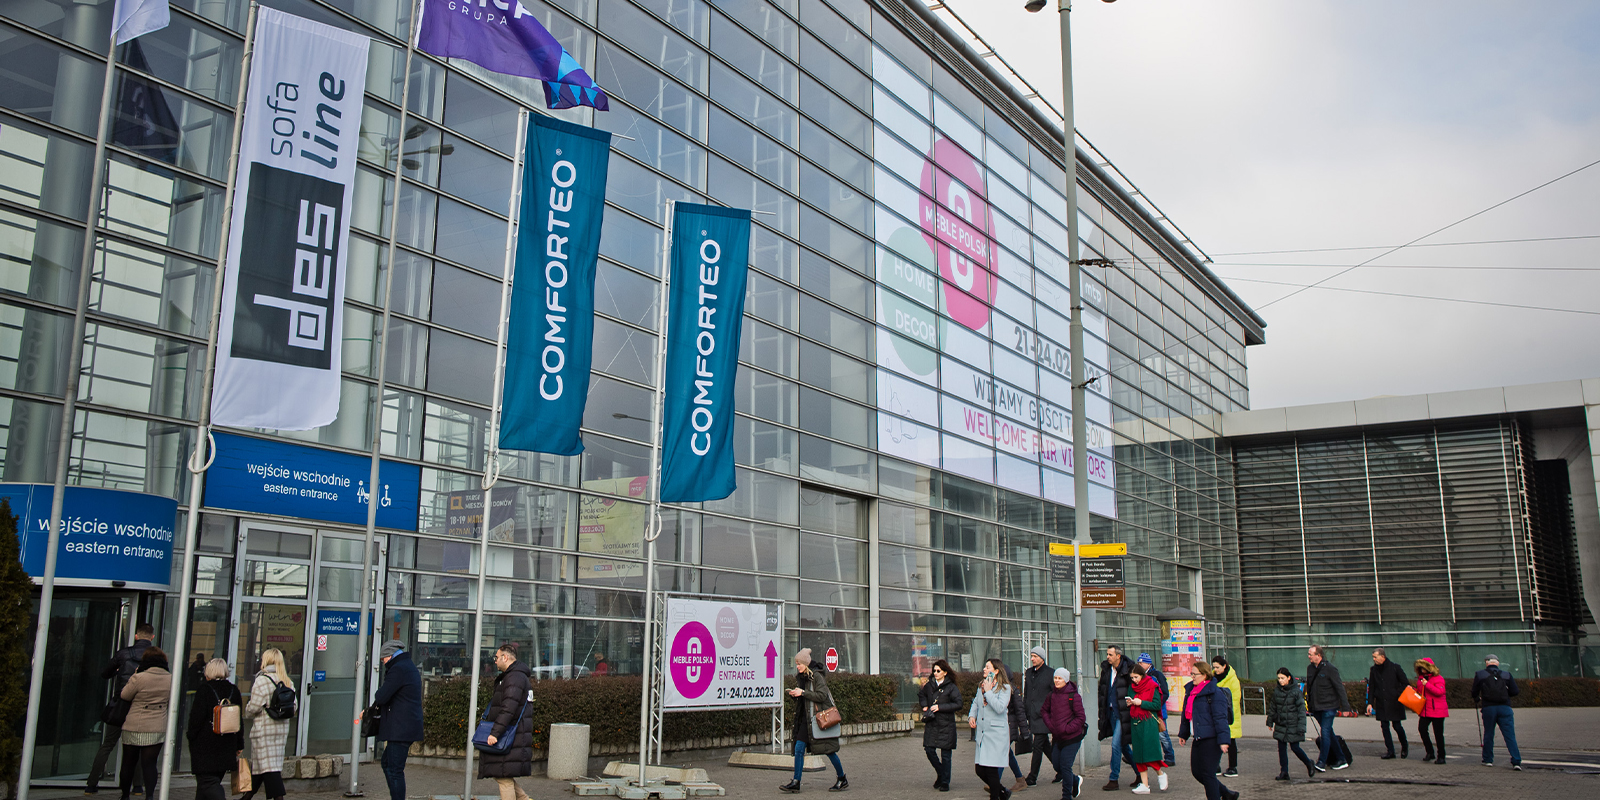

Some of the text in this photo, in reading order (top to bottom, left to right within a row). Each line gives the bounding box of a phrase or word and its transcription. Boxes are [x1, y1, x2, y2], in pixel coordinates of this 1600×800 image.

[448, 1, 508, 26] GRUPA
[267, 81, 299, 159] sofa
[301, 71, 346, 171] line
[925, 205, 957, 237] MEBLE
[254, 199, 336, 351] des
[539, 159, 577, 401] COMFORTEO
[894, 259, 934, 294] HOME
[895, 309, 936, 345] DECOR
[691, 239, 721, 457] COMFORTEO
[1014, 325, 1102, 393] 21-24.02023
[973, 374, 1105, 450] WITAMY GOŚCI TGÓW
[964, 407, 1106, 480] WELCOME FAIR VIORS
[247, 461, 351, 488] wejście wschodnie
[263, 481, 339, 502] eastern entrance
[38, 516, 173, 542] wejście wschodnie
[449, 514, 484, 525] 18-19 MARC
[65, 541, 164, 560] eastern entrance
[322, 615, 344, 624] wejście
[719, 616, 735, 624] HOME
[720, 631, 735, 639] DECOR
[673, 655, 714, 665] MEBLE POLSKA
[719, 653, 750, 667] WEJŚCIE
[826, 656, 838, 664] STOP
[718, 670, 756, 681] ENTRANCE
[717, 686, 774, 699] 21-24.02.2023
